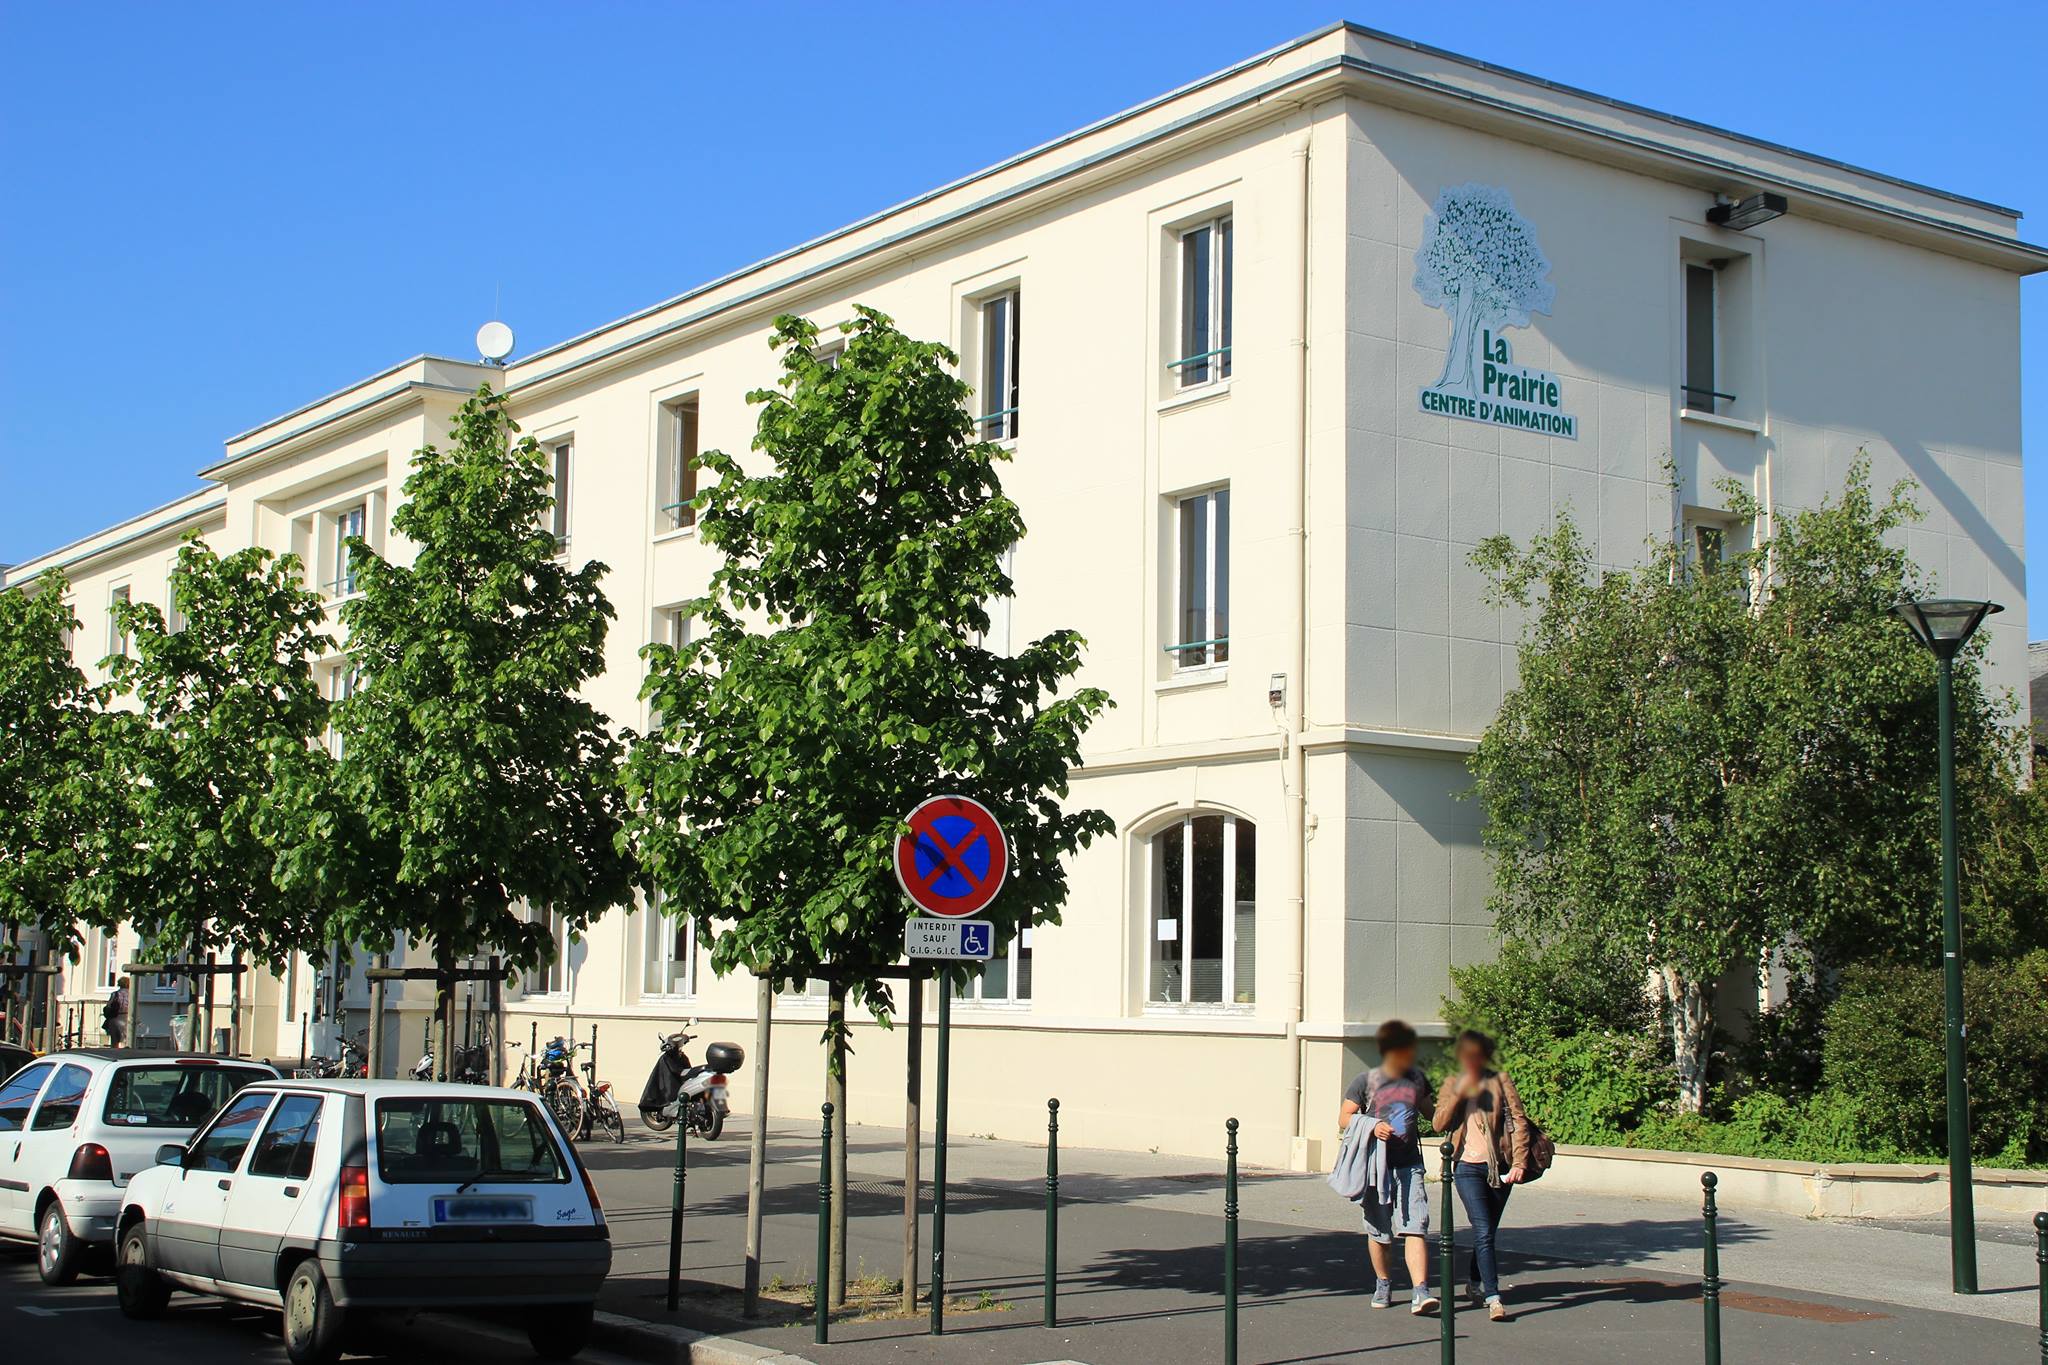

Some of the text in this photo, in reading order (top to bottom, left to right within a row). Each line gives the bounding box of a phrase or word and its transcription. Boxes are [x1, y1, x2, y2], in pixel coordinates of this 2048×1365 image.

[1483, 329, 1508, 364] La
[1483, 363, 1558, 407] Prairie
[1422, 391, 1572, 435] CENTRE D'ANIMATION
[914, 922, 956, 931] INTERDIT
[923, 934, 947, 943] SAUF
[557, 1208, 576, 1221] Saga
[382, 1231, 420, 1240] RENAULT
